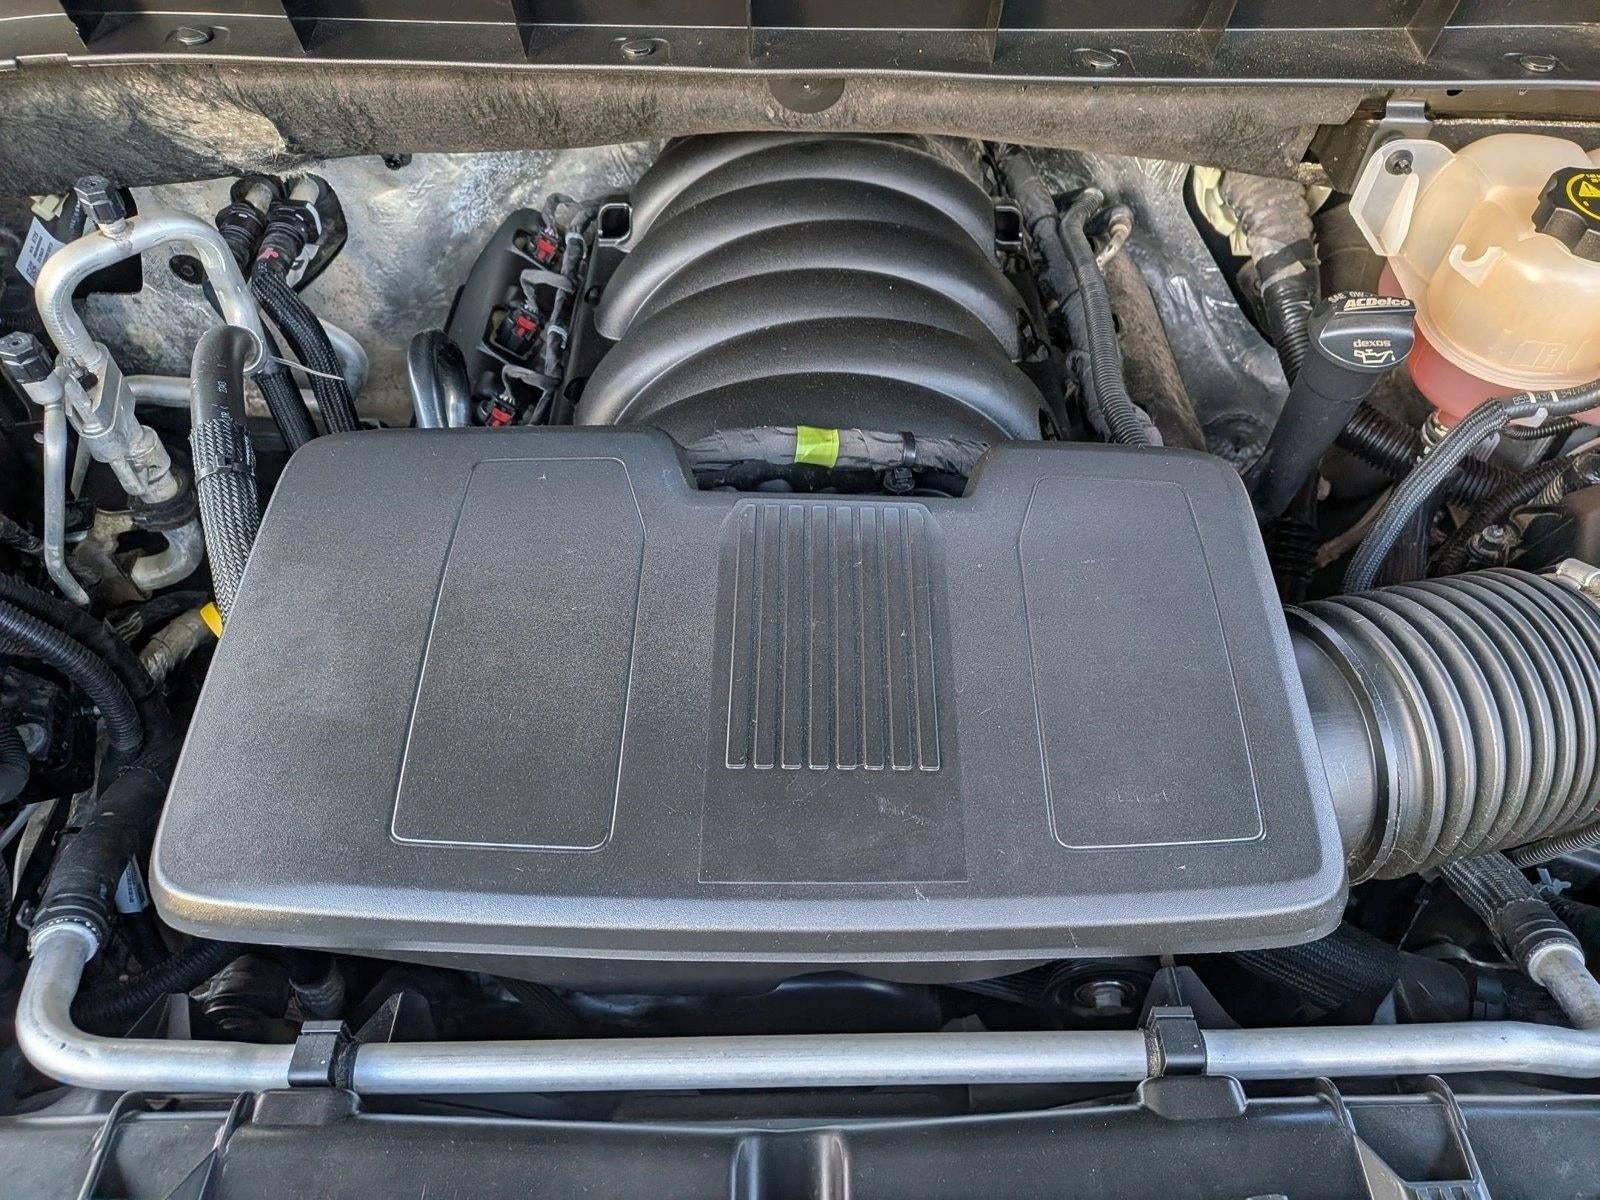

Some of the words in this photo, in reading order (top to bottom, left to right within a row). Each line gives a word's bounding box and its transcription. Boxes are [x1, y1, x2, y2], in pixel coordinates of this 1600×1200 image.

[1328, 292, 1347, 303] SAE
[1343, 297, 1410, 309] ACDelco
[1353, 339, 1391, 348] dexos
